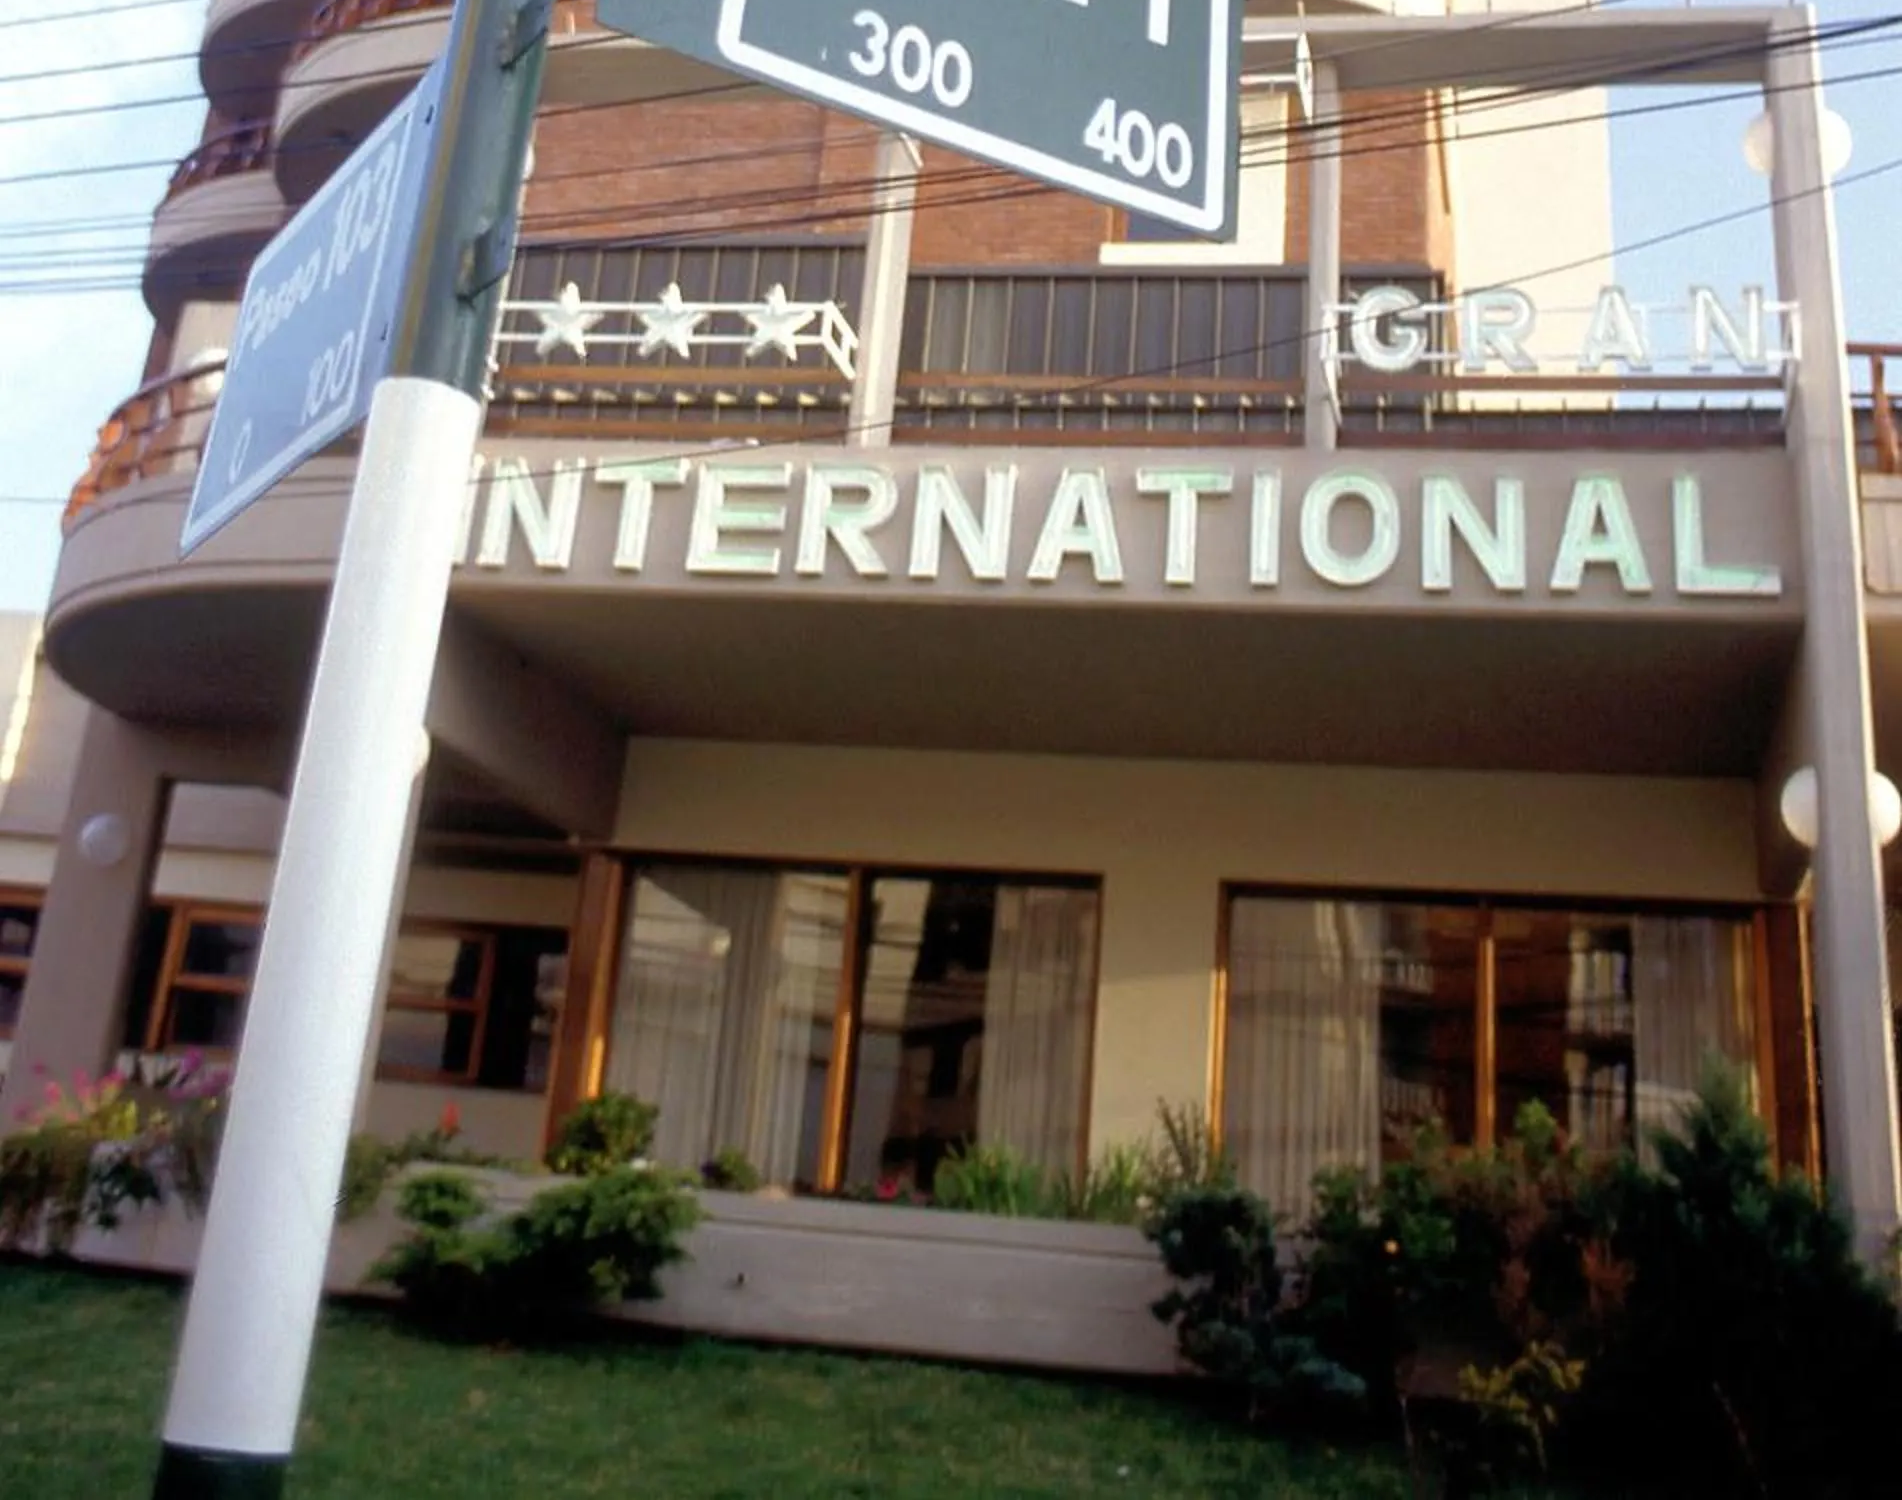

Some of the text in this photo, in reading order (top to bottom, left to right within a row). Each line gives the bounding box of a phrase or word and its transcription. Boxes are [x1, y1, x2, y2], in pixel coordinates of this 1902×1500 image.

[849, 10, 1193, 189] 300 400
[323, 140, 397, 291] 103
[1350, 285, 1768, 373] GRAN
